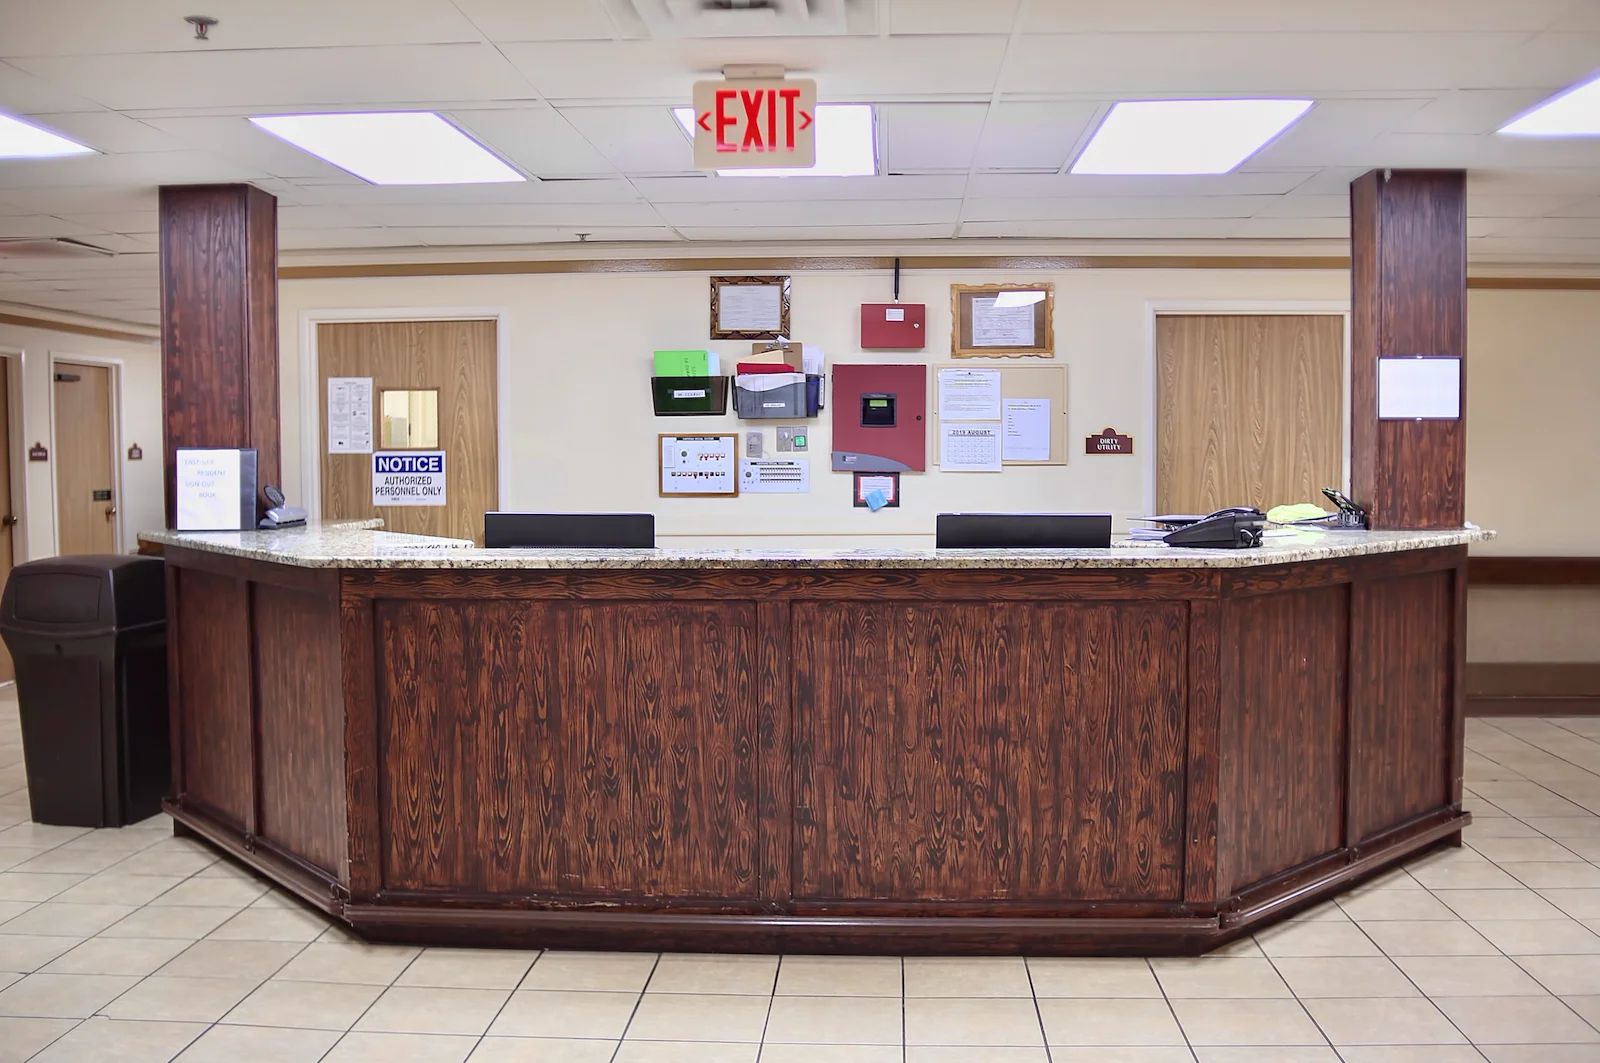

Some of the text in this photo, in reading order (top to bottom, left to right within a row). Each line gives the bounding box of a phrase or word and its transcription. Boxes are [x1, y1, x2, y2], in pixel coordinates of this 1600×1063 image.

[715, 88, 801, 153] EXIT
[378, 457, 440, 472] NOTICE
[384, 476, 432, 485] AUTHORIZED
[375, 486, 442, 496] PERSONNEL ONLY
